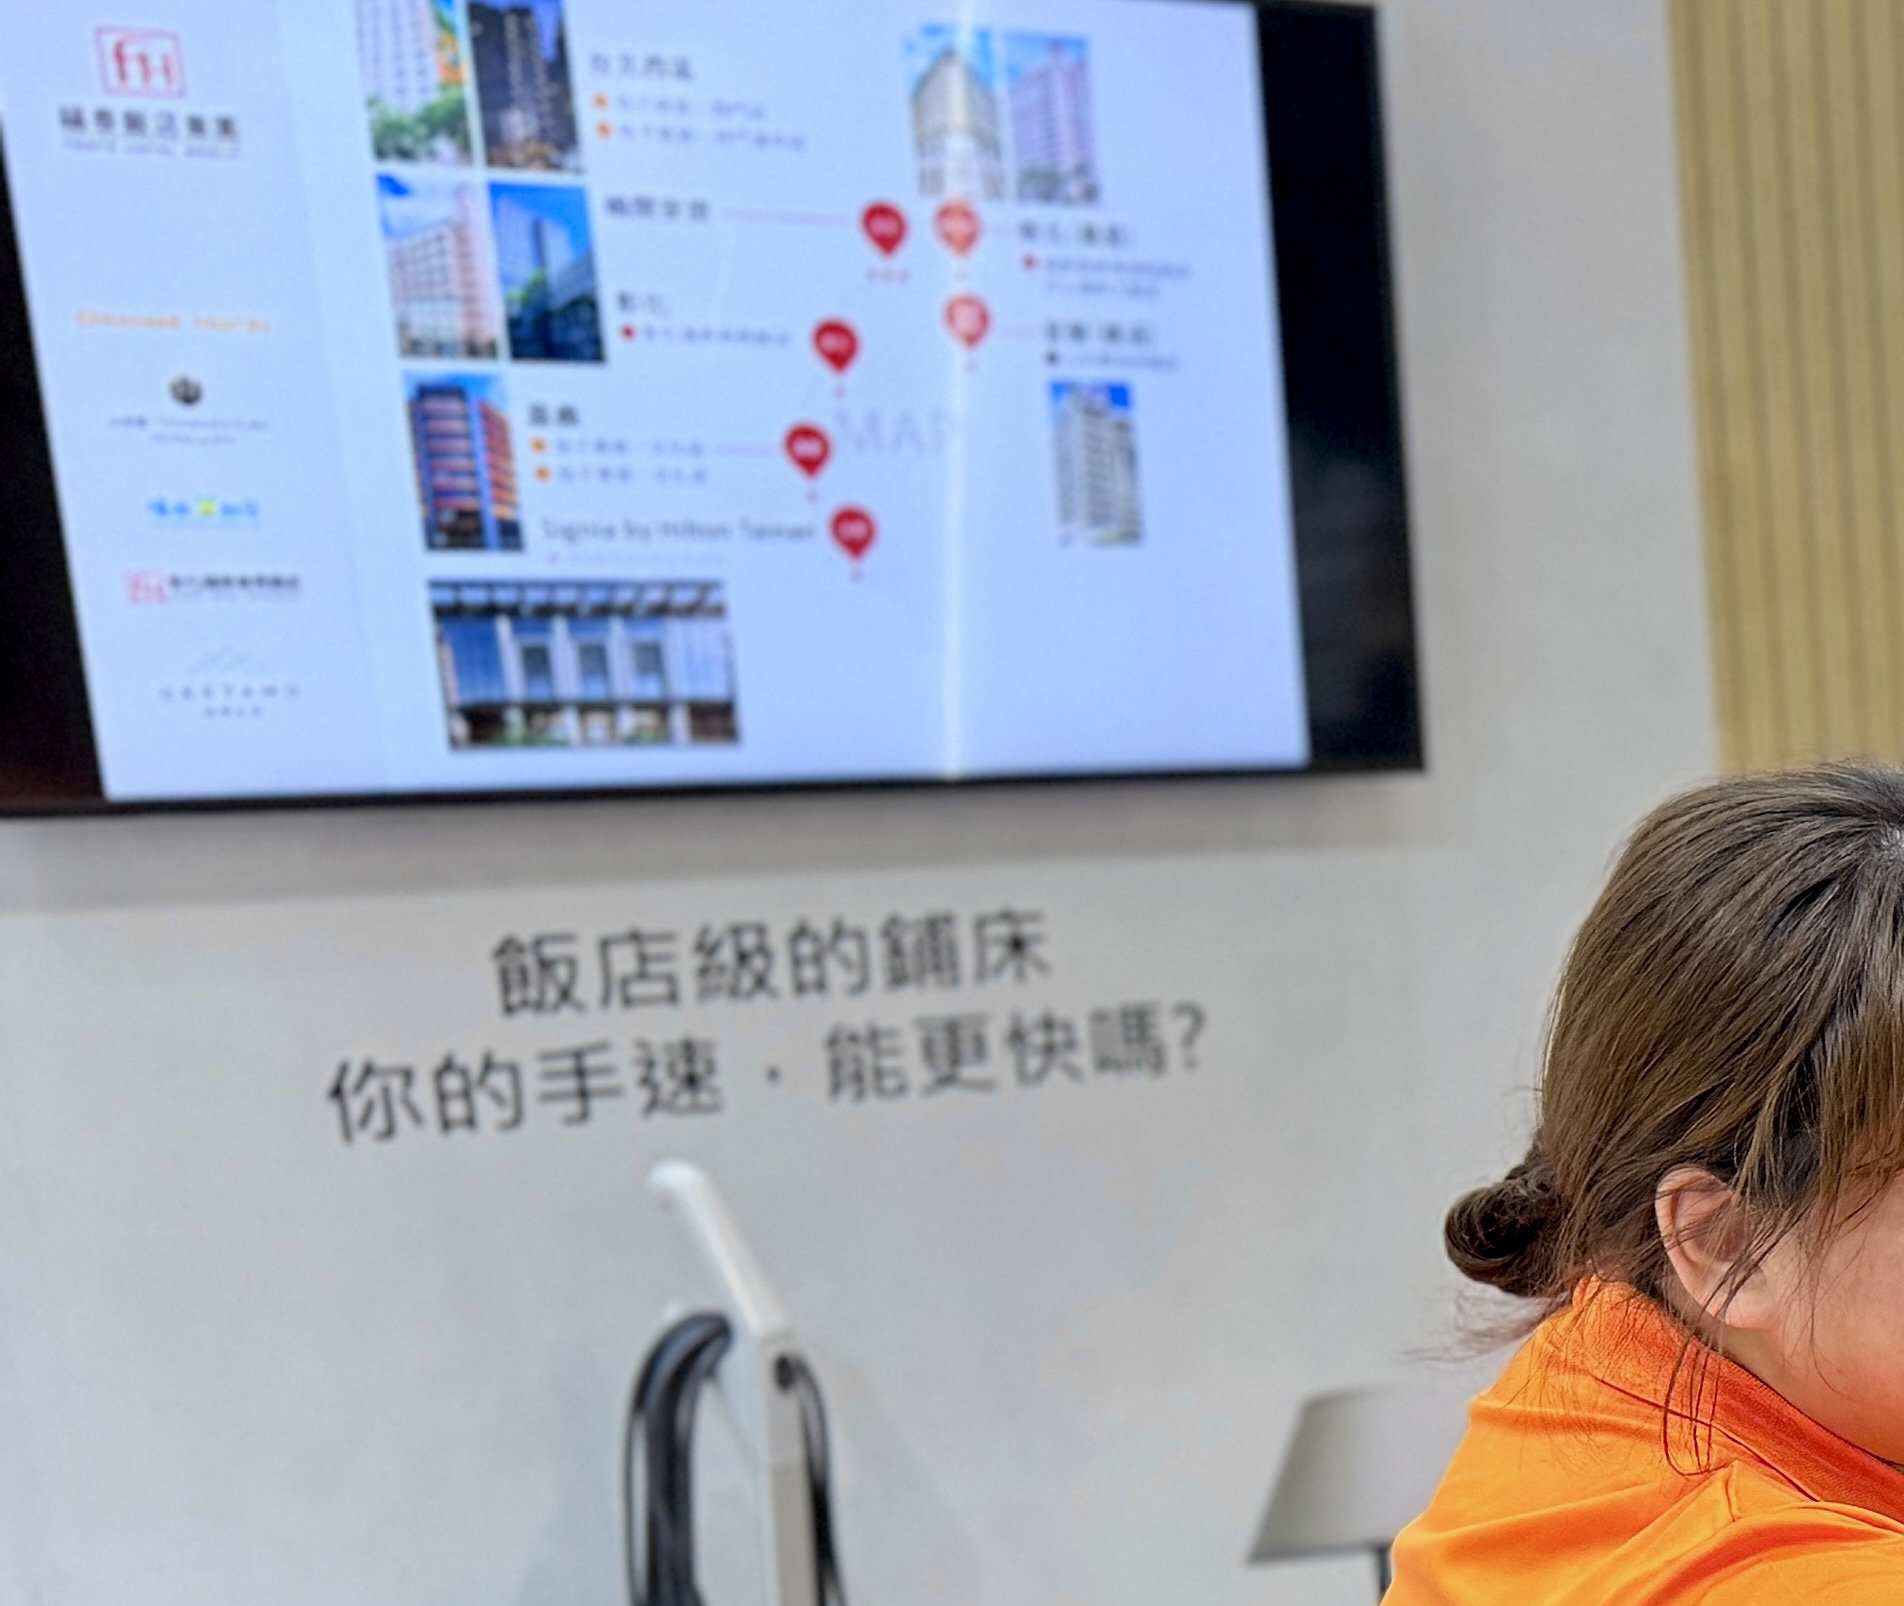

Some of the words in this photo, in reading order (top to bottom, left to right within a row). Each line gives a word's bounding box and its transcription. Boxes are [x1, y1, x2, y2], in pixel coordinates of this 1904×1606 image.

[490, 908, 1054, 1020] 飯店級的鋪床
